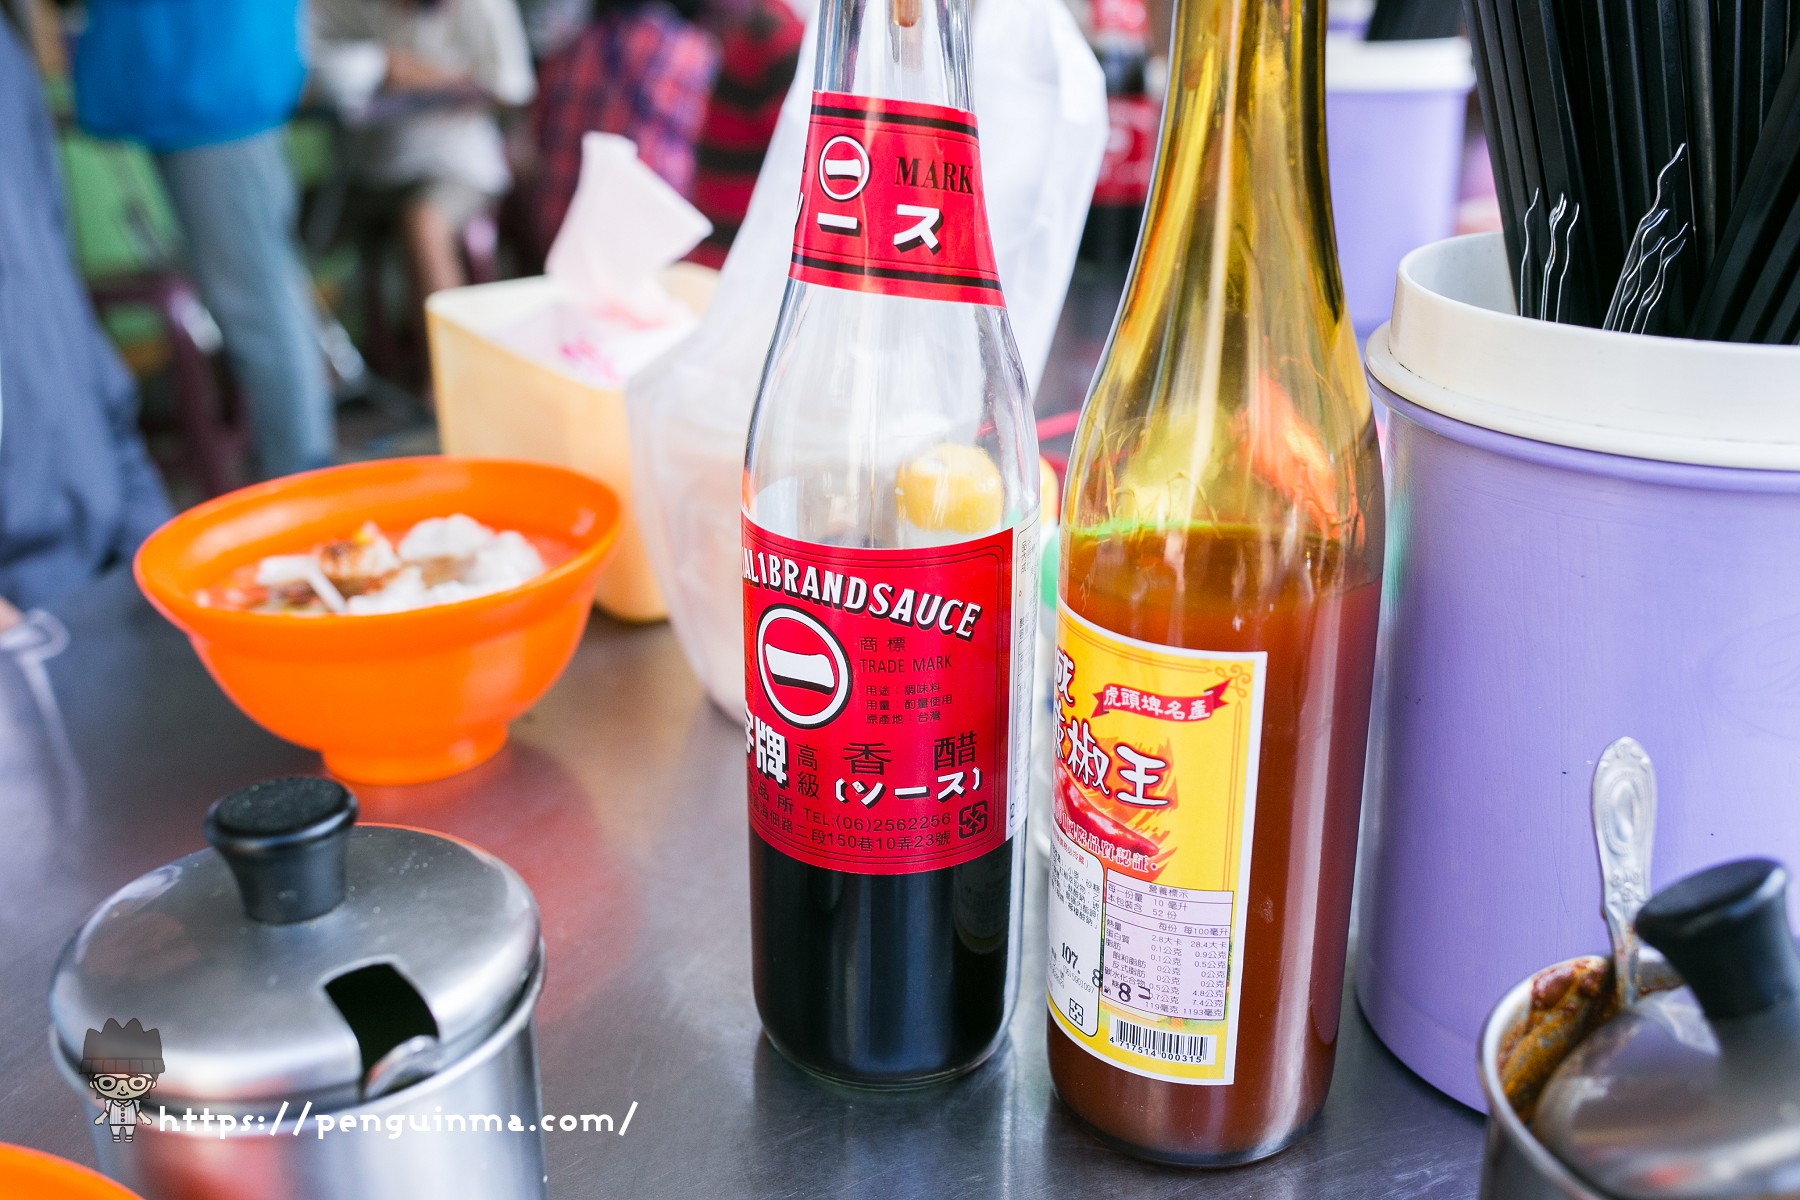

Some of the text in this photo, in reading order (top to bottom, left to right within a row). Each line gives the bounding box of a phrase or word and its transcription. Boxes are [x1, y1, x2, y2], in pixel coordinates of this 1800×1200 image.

[895, 156, 974, 195] MARK
[860, 636, 906, 653] 商標
[860, 654, 952, 674] TRADE MARK
[1103, 685, 1212, 721] 虎頭埤名產
[802, 807, 951, 832] TEL:(06)2562256
[1148, 884, 1189, 899] 營養標示
[1153, 899, 1164, 907] 10
[1152, 909, 1164, 918] 52
[1159, 922, 1178, 933] 每份
[1190, 941, 1227, 949] 28.4大卡
[1120, 1040, 1157, 1057] 717514
[1161, 1052, 1202, 1063] 000315
